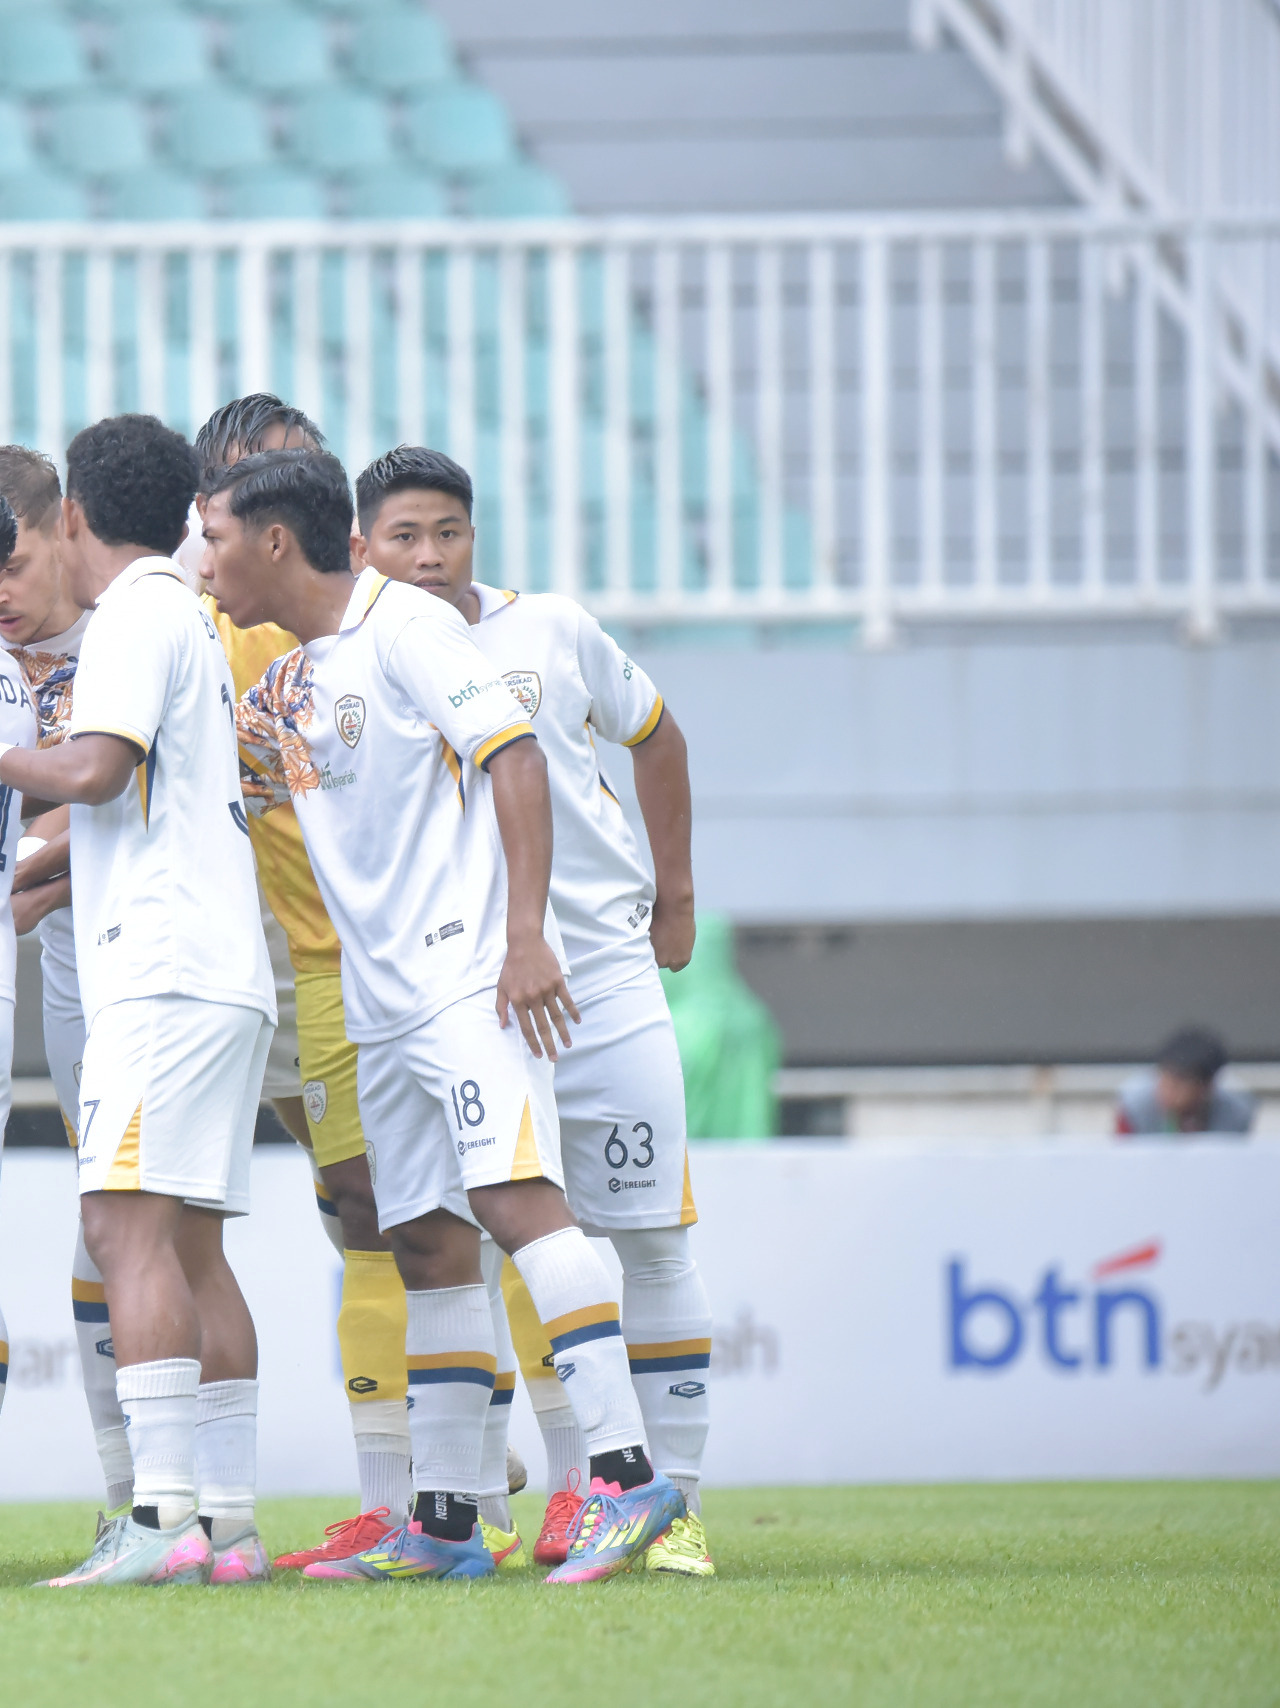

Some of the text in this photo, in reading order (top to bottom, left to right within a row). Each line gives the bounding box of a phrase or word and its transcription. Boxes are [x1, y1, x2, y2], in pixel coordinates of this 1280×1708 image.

[448, 680, 480, 708] btn
[451, 1080, 485, 1131] 18
[605, 1122, 655, 1169] 63
[624, 1179, 657, 1190] EREIGHT
[945, 1242, 1162, 1370] btn
